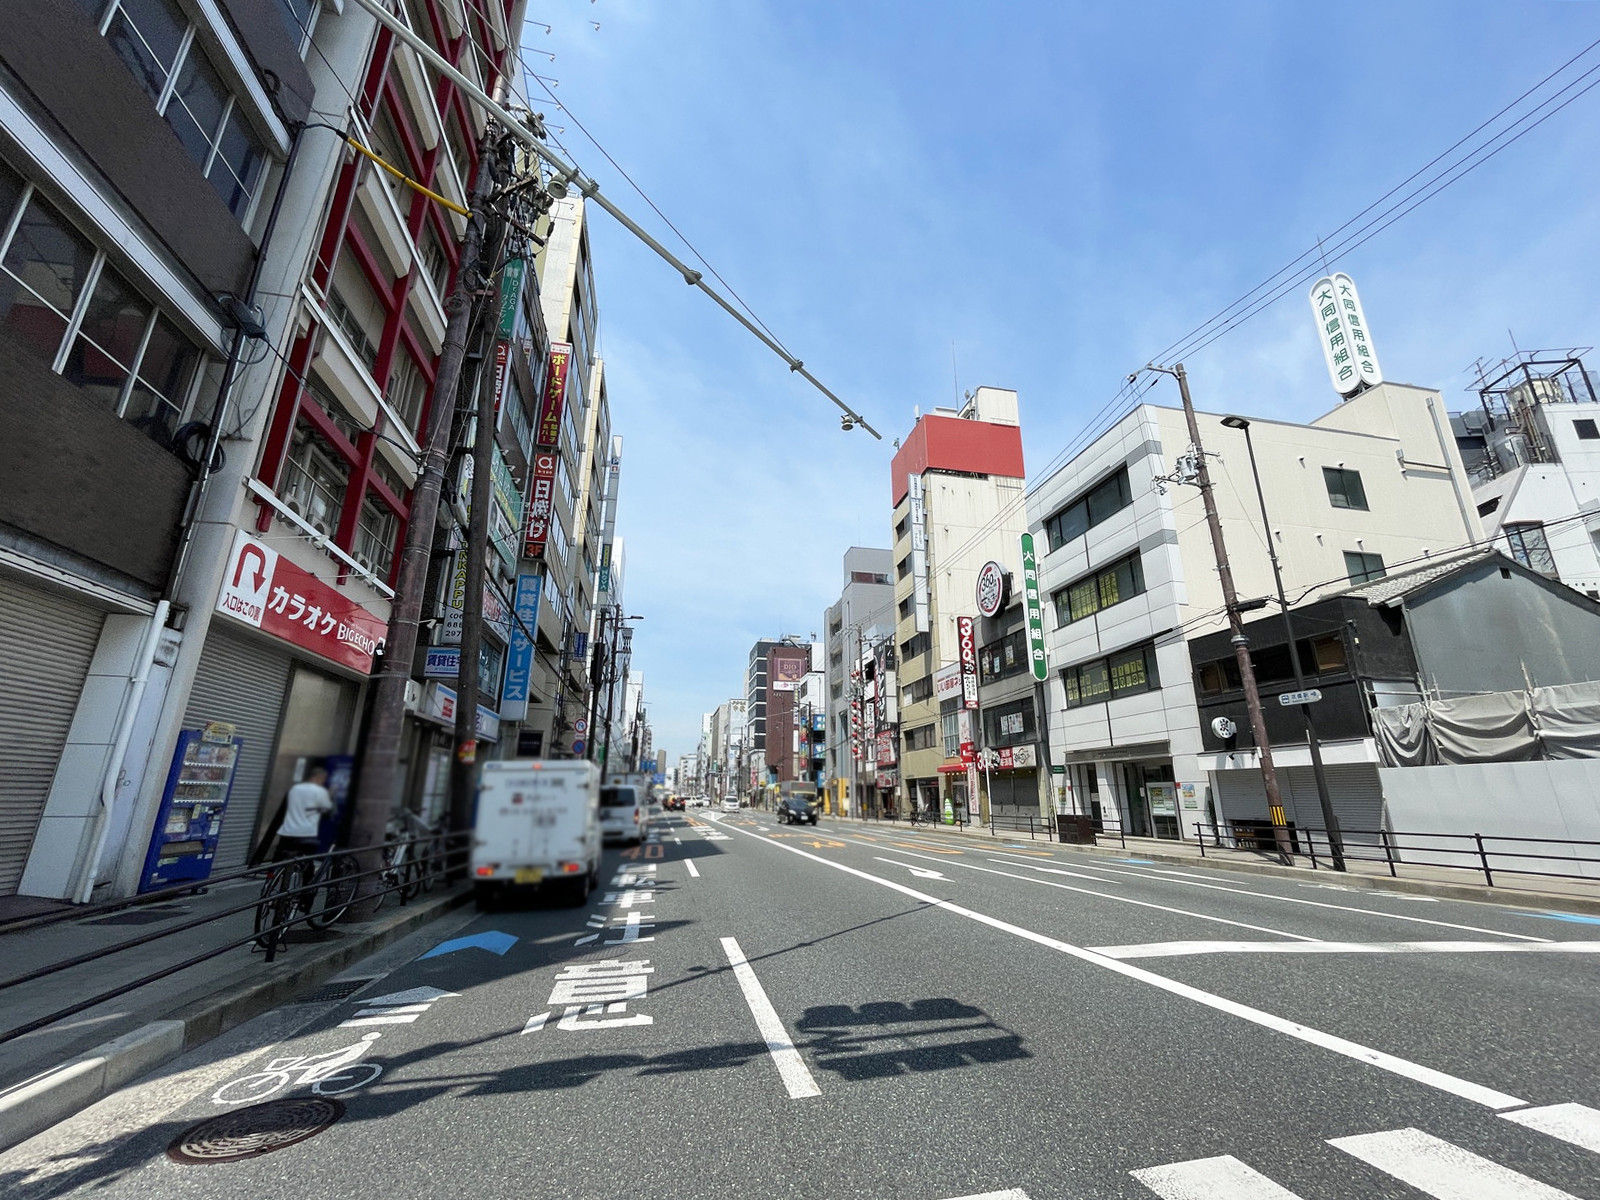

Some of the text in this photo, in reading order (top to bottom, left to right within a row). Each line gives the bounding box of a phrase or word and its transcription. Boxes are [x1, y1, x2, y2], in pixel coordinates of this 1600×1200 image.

[1317, 289, 1353, 381] 大同信用組合
[1339, 284, 1374, 374] 大同信用組合
[545, 354, 566, 422] ボードゲーム
[528, 480, 552, 538] 日焼け
[222, 592, 263, 622] 入口はこの裏
[600, 569, 609, 590] NOVA
[1023, 551, 1044, 660] 大同信用組合
[268, 585, 337, 635] カラオケ
[507, 578, 538, 699] 賃貸住宅サービス
[960, 618, 973, 661] 360
[620, 845, 665, 859] 40
